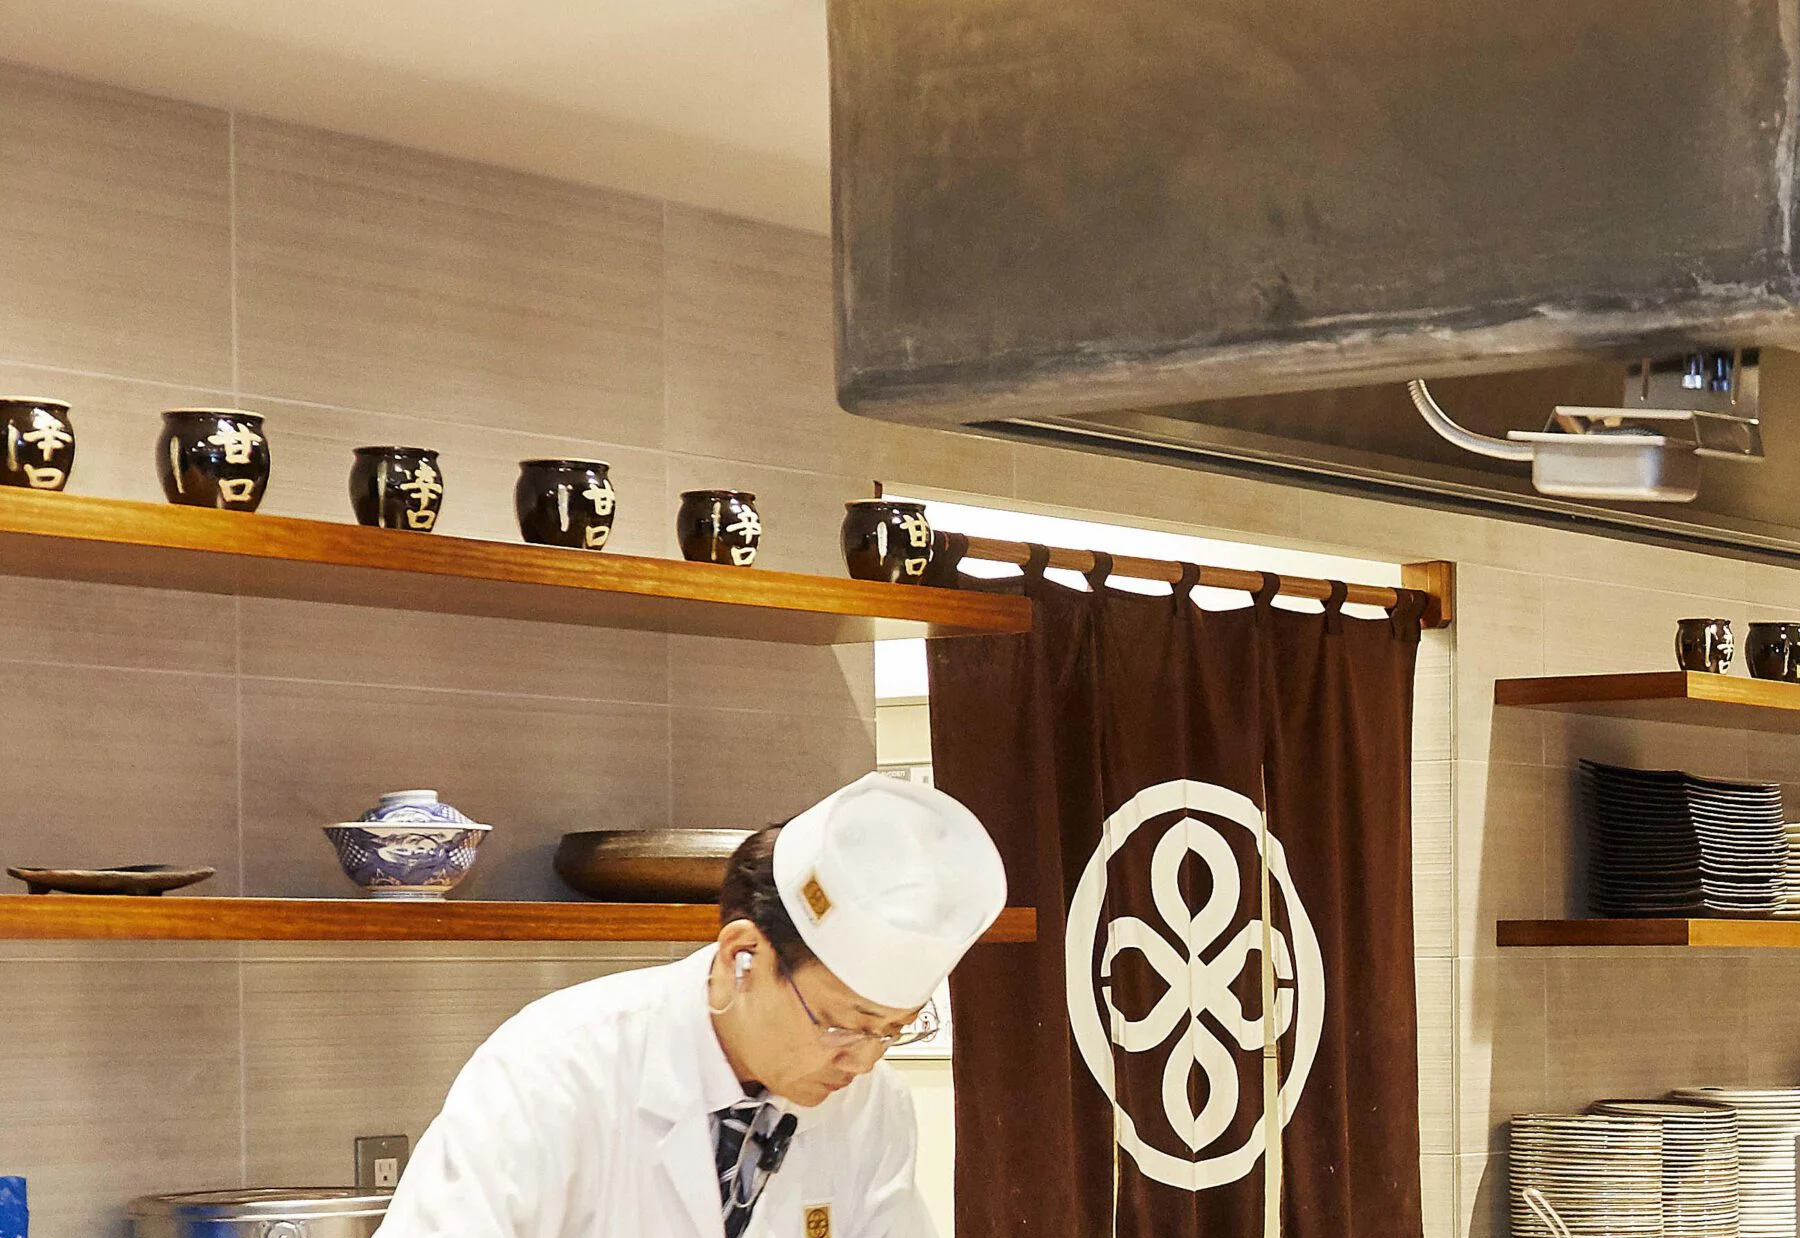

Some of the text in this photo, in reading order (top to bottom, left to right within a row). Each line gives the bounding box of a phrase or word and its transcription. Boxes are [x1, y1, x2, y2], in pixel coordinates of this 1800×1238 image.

[208, 421, 263, 501] 甘口
[400, 460, 442, 529] 辛口
[583, 480, 615, 547] 甘口
[726, 504, 761, 566] 辛口
[900, 513, 929, 576] 甘口
